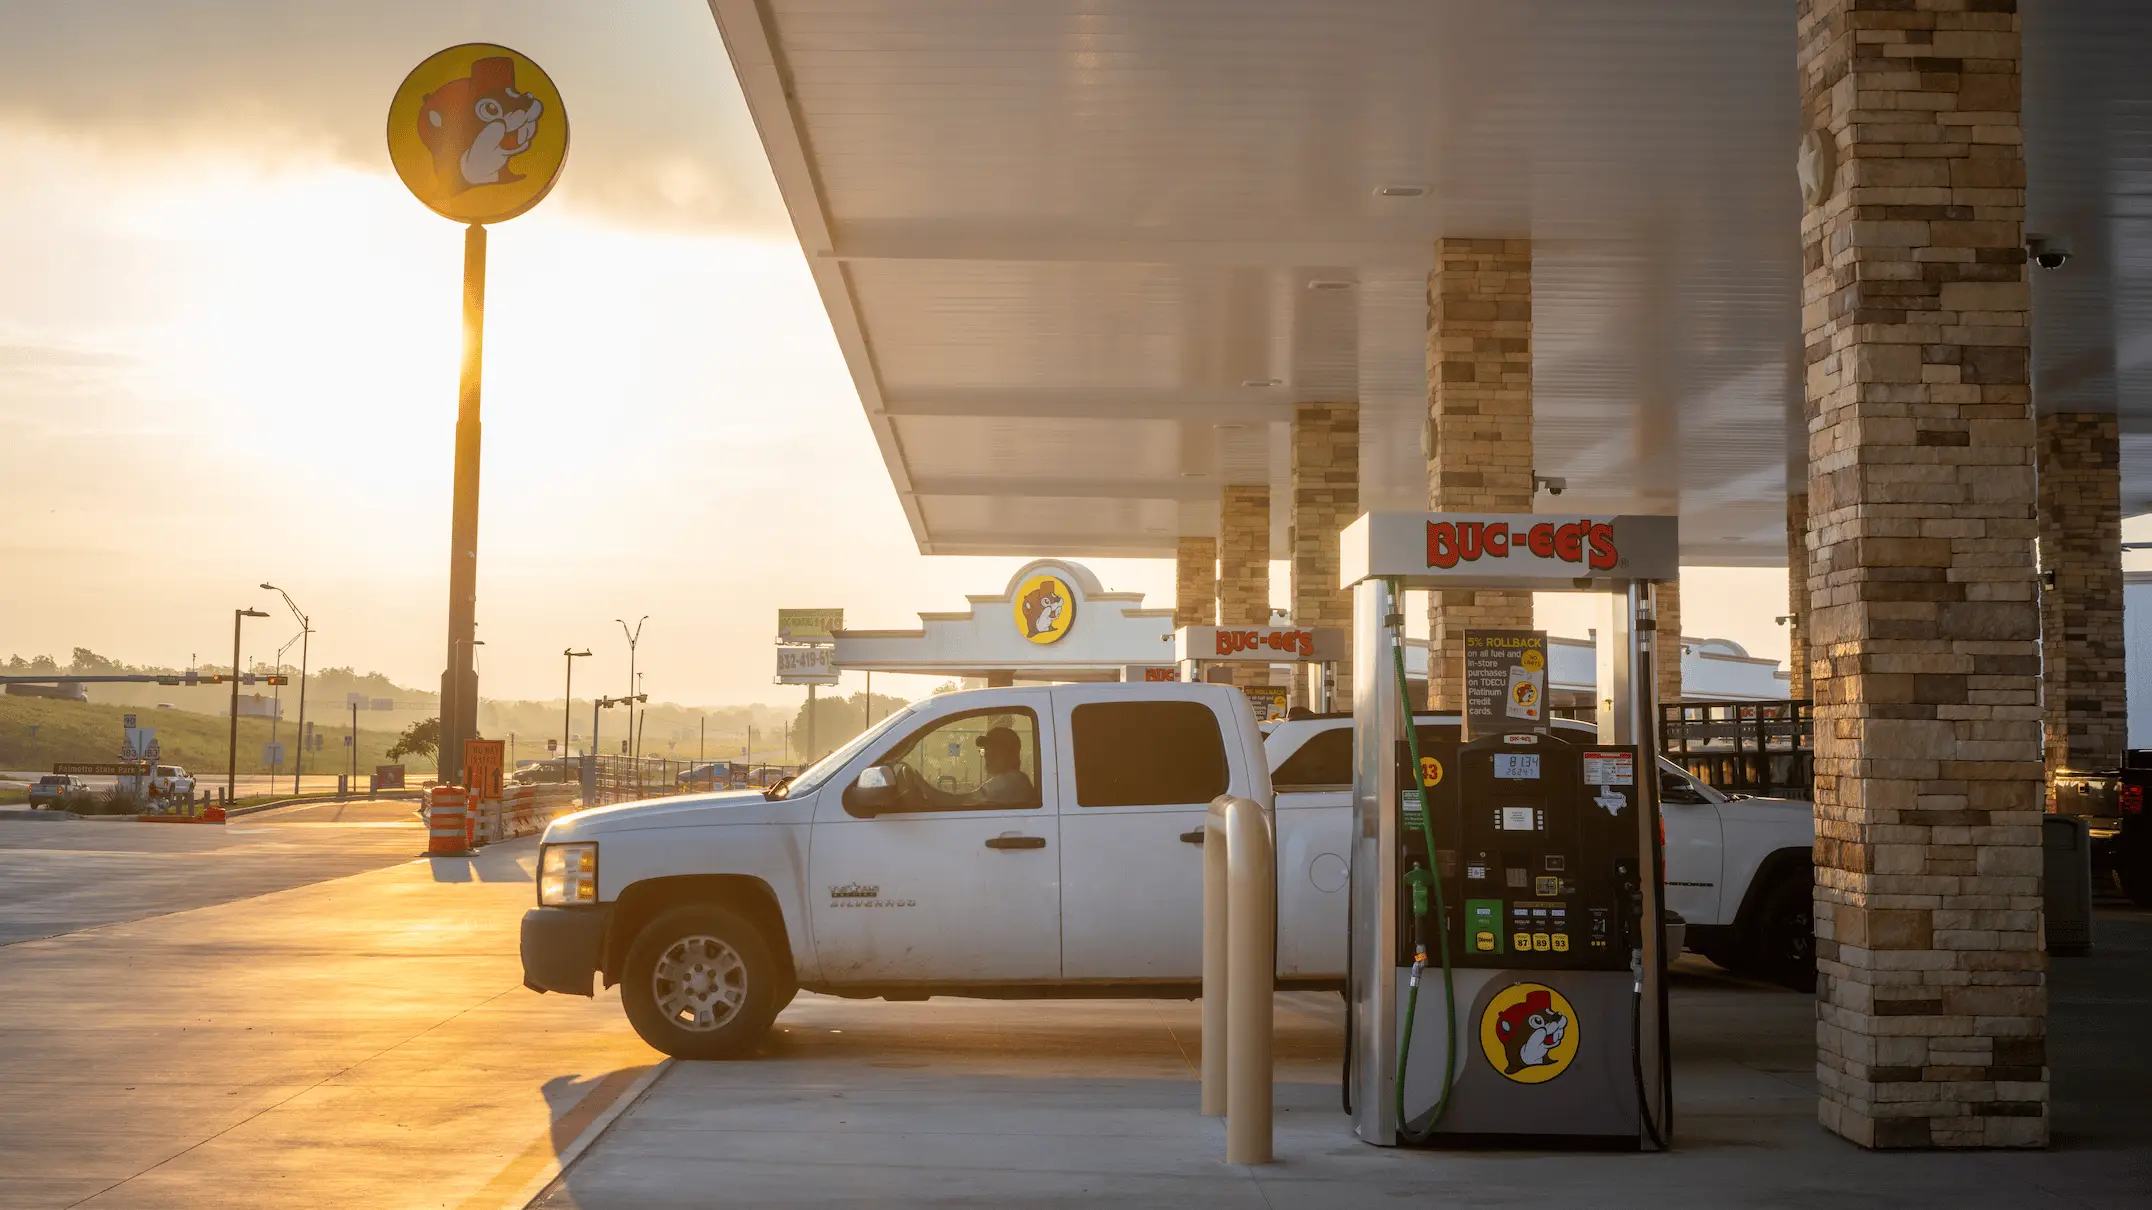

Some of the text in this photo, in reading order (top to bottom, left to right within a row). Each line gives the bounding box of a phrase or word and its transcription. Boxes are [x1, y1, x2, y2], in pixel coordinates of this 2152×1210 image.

[1427, 520, 1618, 570] BUC-EE'S
[1216, 630, 1315, 656] BUC-EE'S
[1467, 637, 1542, 648] 5% ROLLBACK
[1480, 649, 1489, 657] all
[1491, 649, 1505, 657] fuel
[1467, 659, 1498, 667] in-store
[1468, 669, 1507, 678] purchases
[1480, 678, 1506, 686] TDECU
[1468, 688, 1502, 696] Platinum
[1469, 697, 1491, 706] credit
[1469, 707, 1493, 715] cards.
[123, 749, 158, 758] 183 183
[58, 765, 93, 773] Palmetto
[95, 766, 116, 774] State
[1517, 939, 1528, 947] 87
